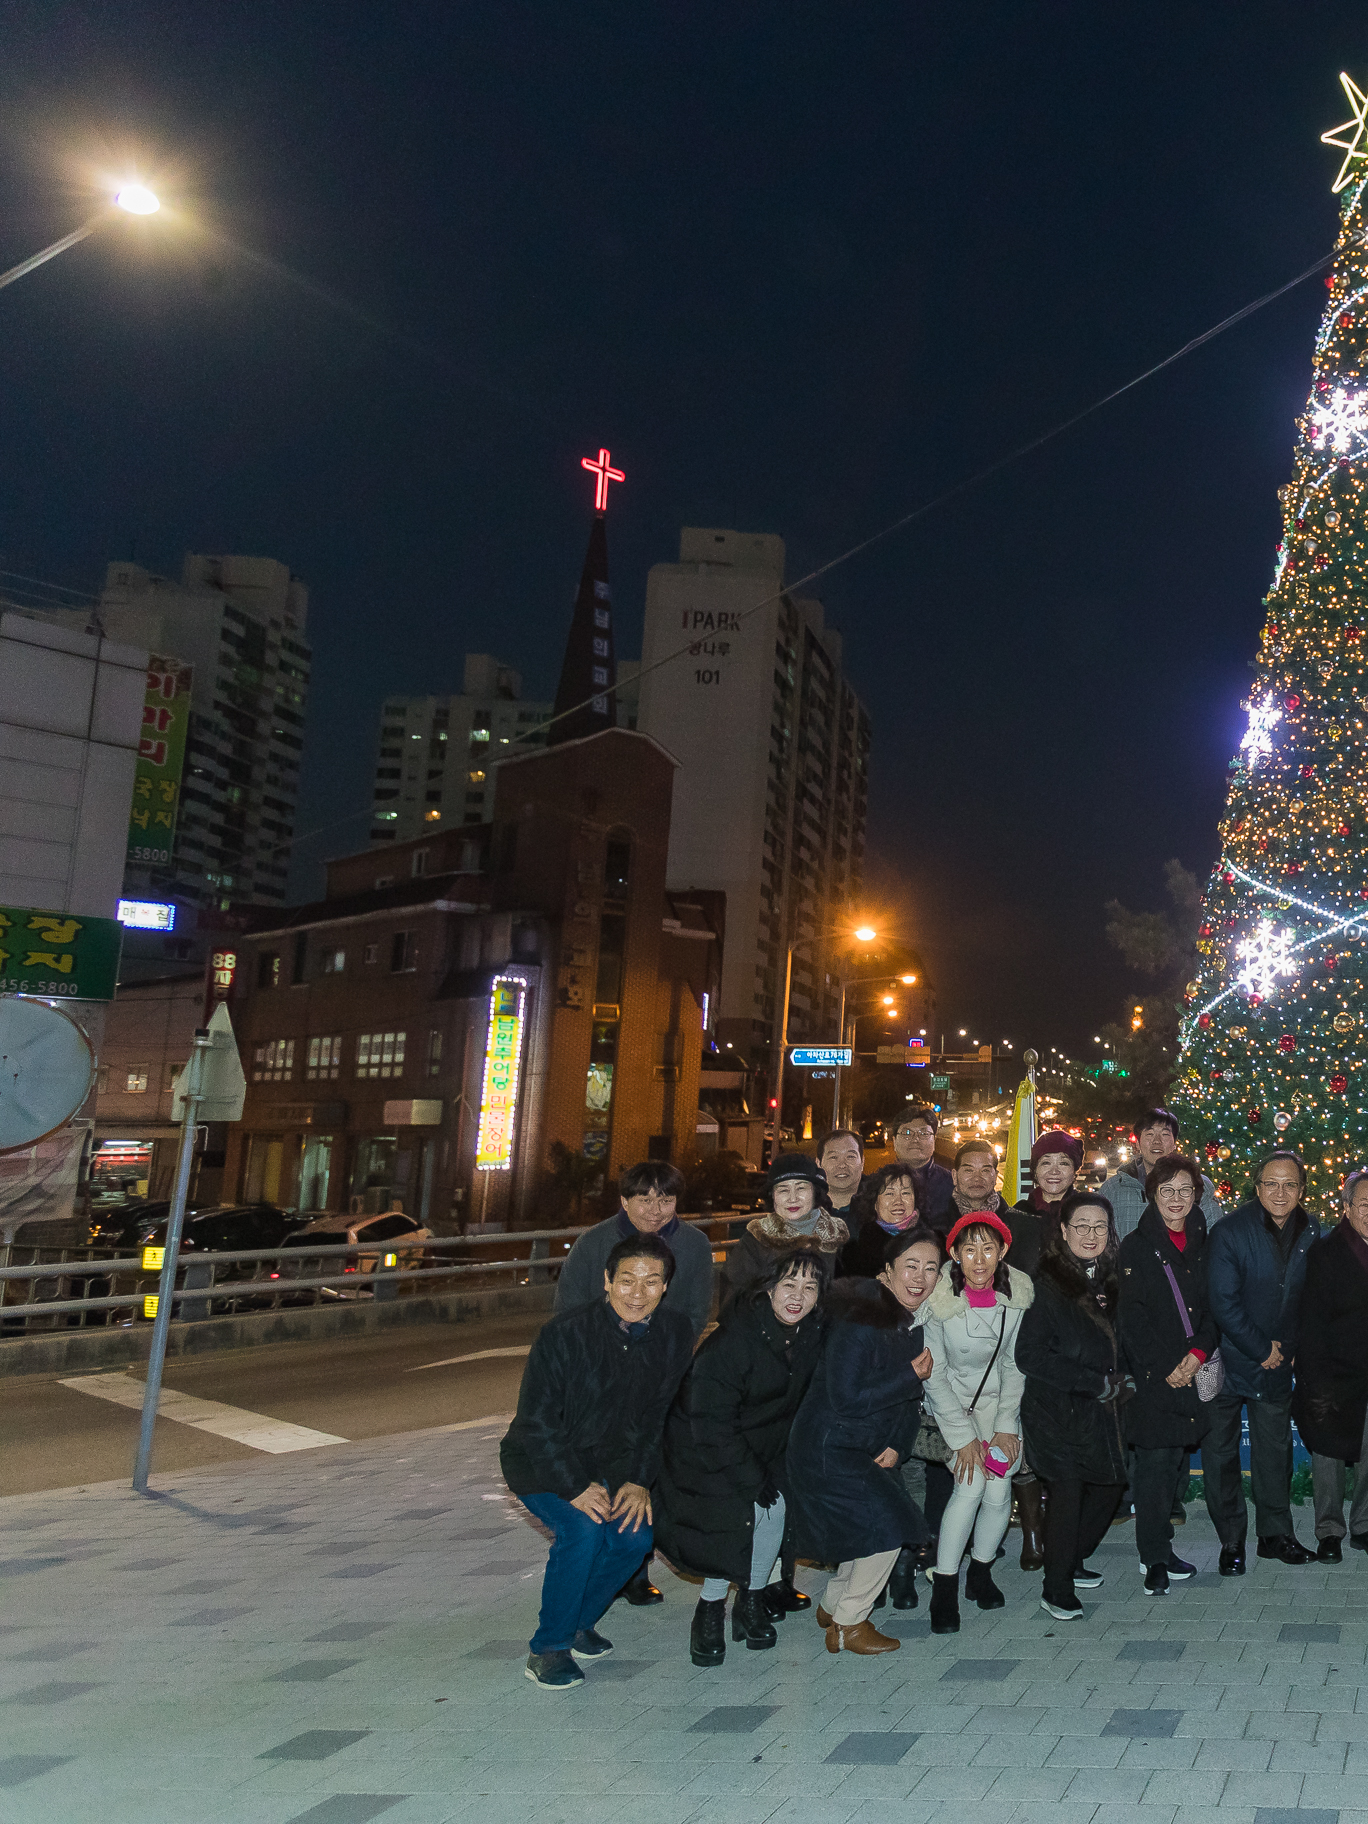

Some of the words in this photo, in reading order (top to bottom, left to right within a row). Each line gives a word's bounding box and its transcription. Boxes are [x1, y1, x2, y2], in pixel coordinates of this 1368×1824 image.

[695, 669, 720, 685] 101
[492, 1017, 516, 1091] 남원추어탕
[484, 1095, 507, 1157] 민물장어
